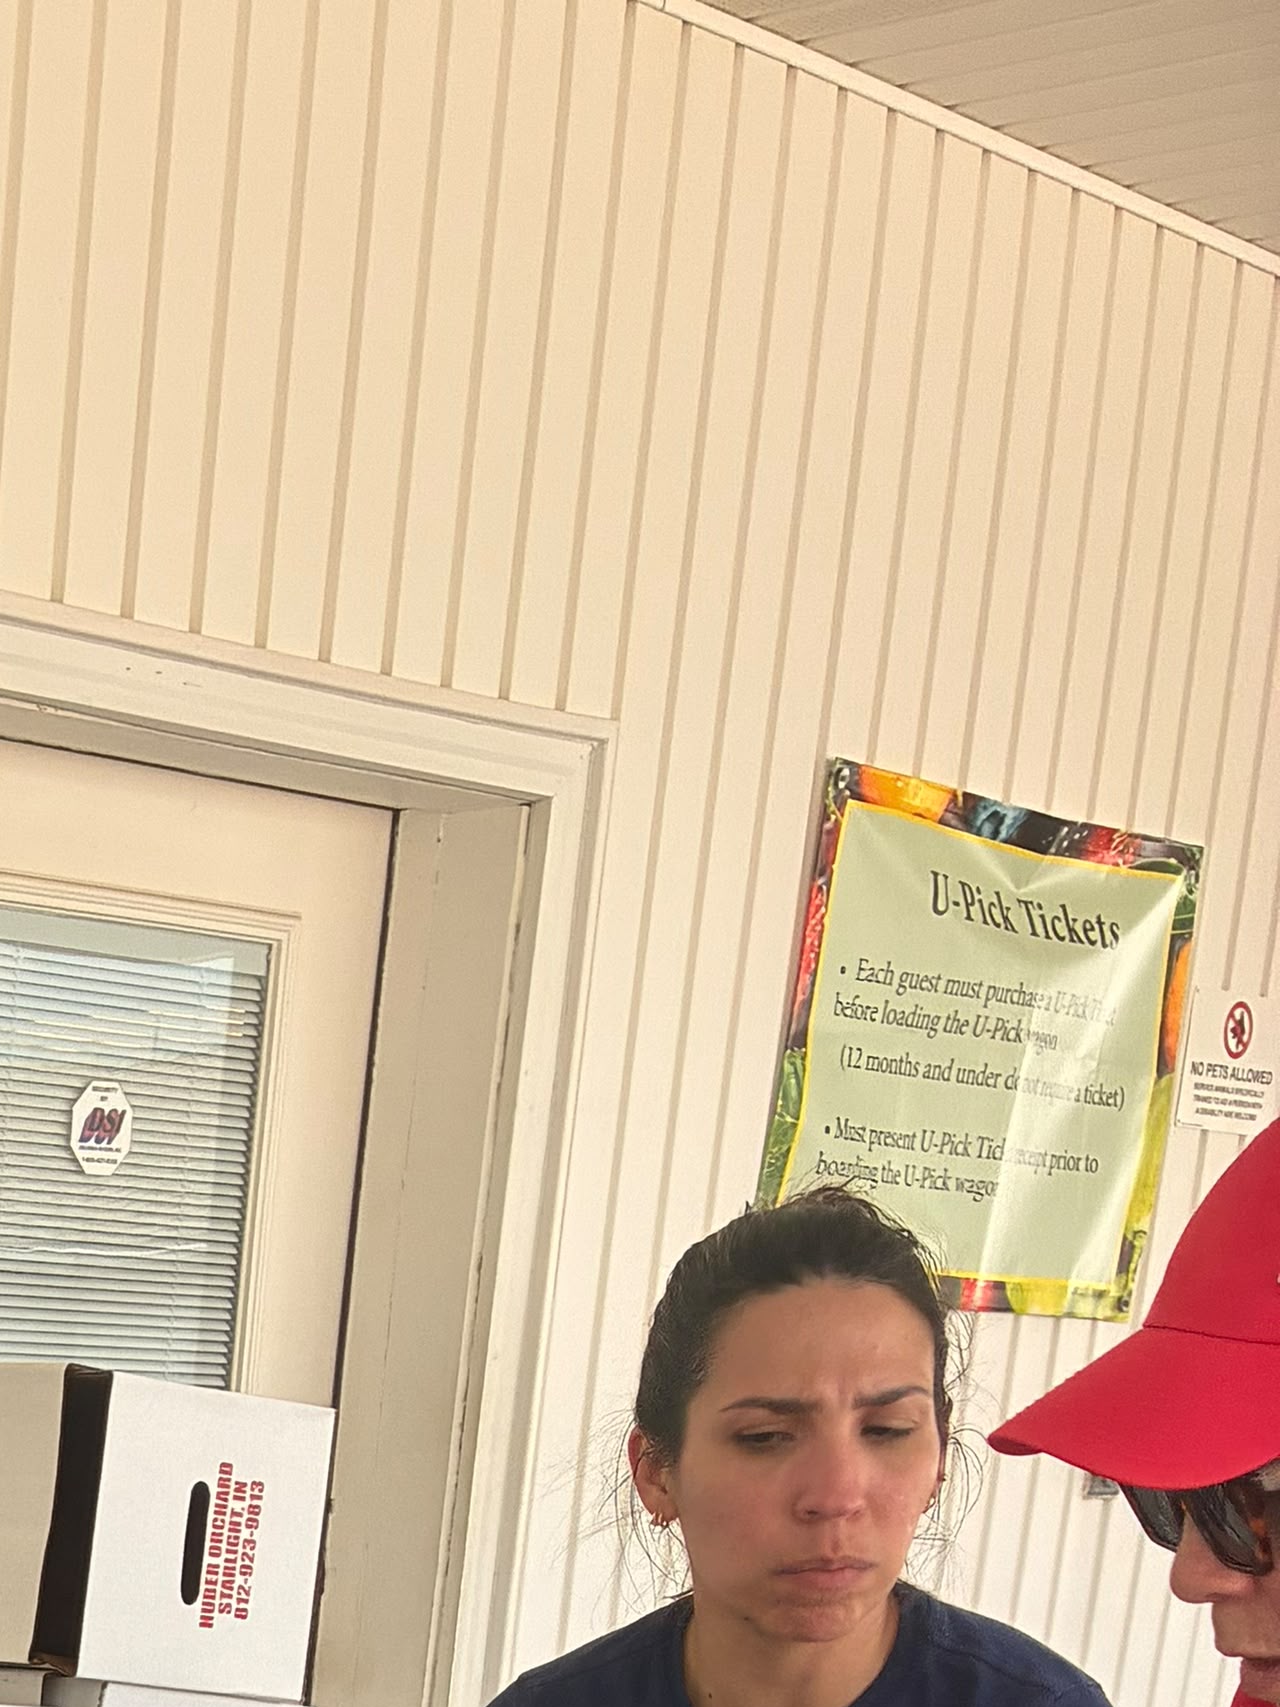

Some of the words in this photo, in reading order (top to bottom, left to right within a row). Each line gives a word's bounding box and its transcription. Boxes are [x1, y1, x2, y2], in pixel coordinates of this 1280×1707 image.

[930, 870, 1019, 934] U-Pick
[1017, 898, 1120, 949] Tickets
[855, 958, 894, 986] Each
[896, 969, 941, 996] guest
[943, 978, 982, 999] must
[834, 992, 878, 1023] before
[881, 1000, 940, 1038] loading
[943, 1010, 969, 1036] the
[973, 1015, 1023, 1044] U-Pick
[840, 1044, 861, 1071] (12
[865, 1052, 920, 1078] months
[923, 1058, 952, 1083] and
[956, 1064, 1002, 1089] under
[1190, 1061, 1204, 1077] NO
[1206, 1063, 1229, 1080] PETS
[1230, 1067, 1273, 1085] ALLOWED
[834, 1116, 866, 1143] Must
[868, 1127, 916, 1152] present
[920, 1129, 972, 1158] U-Pick
[1048, 1149, 1082, 1176] prior
[1085, 1153, 1099, 1174] to
[880, 1160, 900, 1187] the
[904, 1163, 951, 1192] U-Pick
